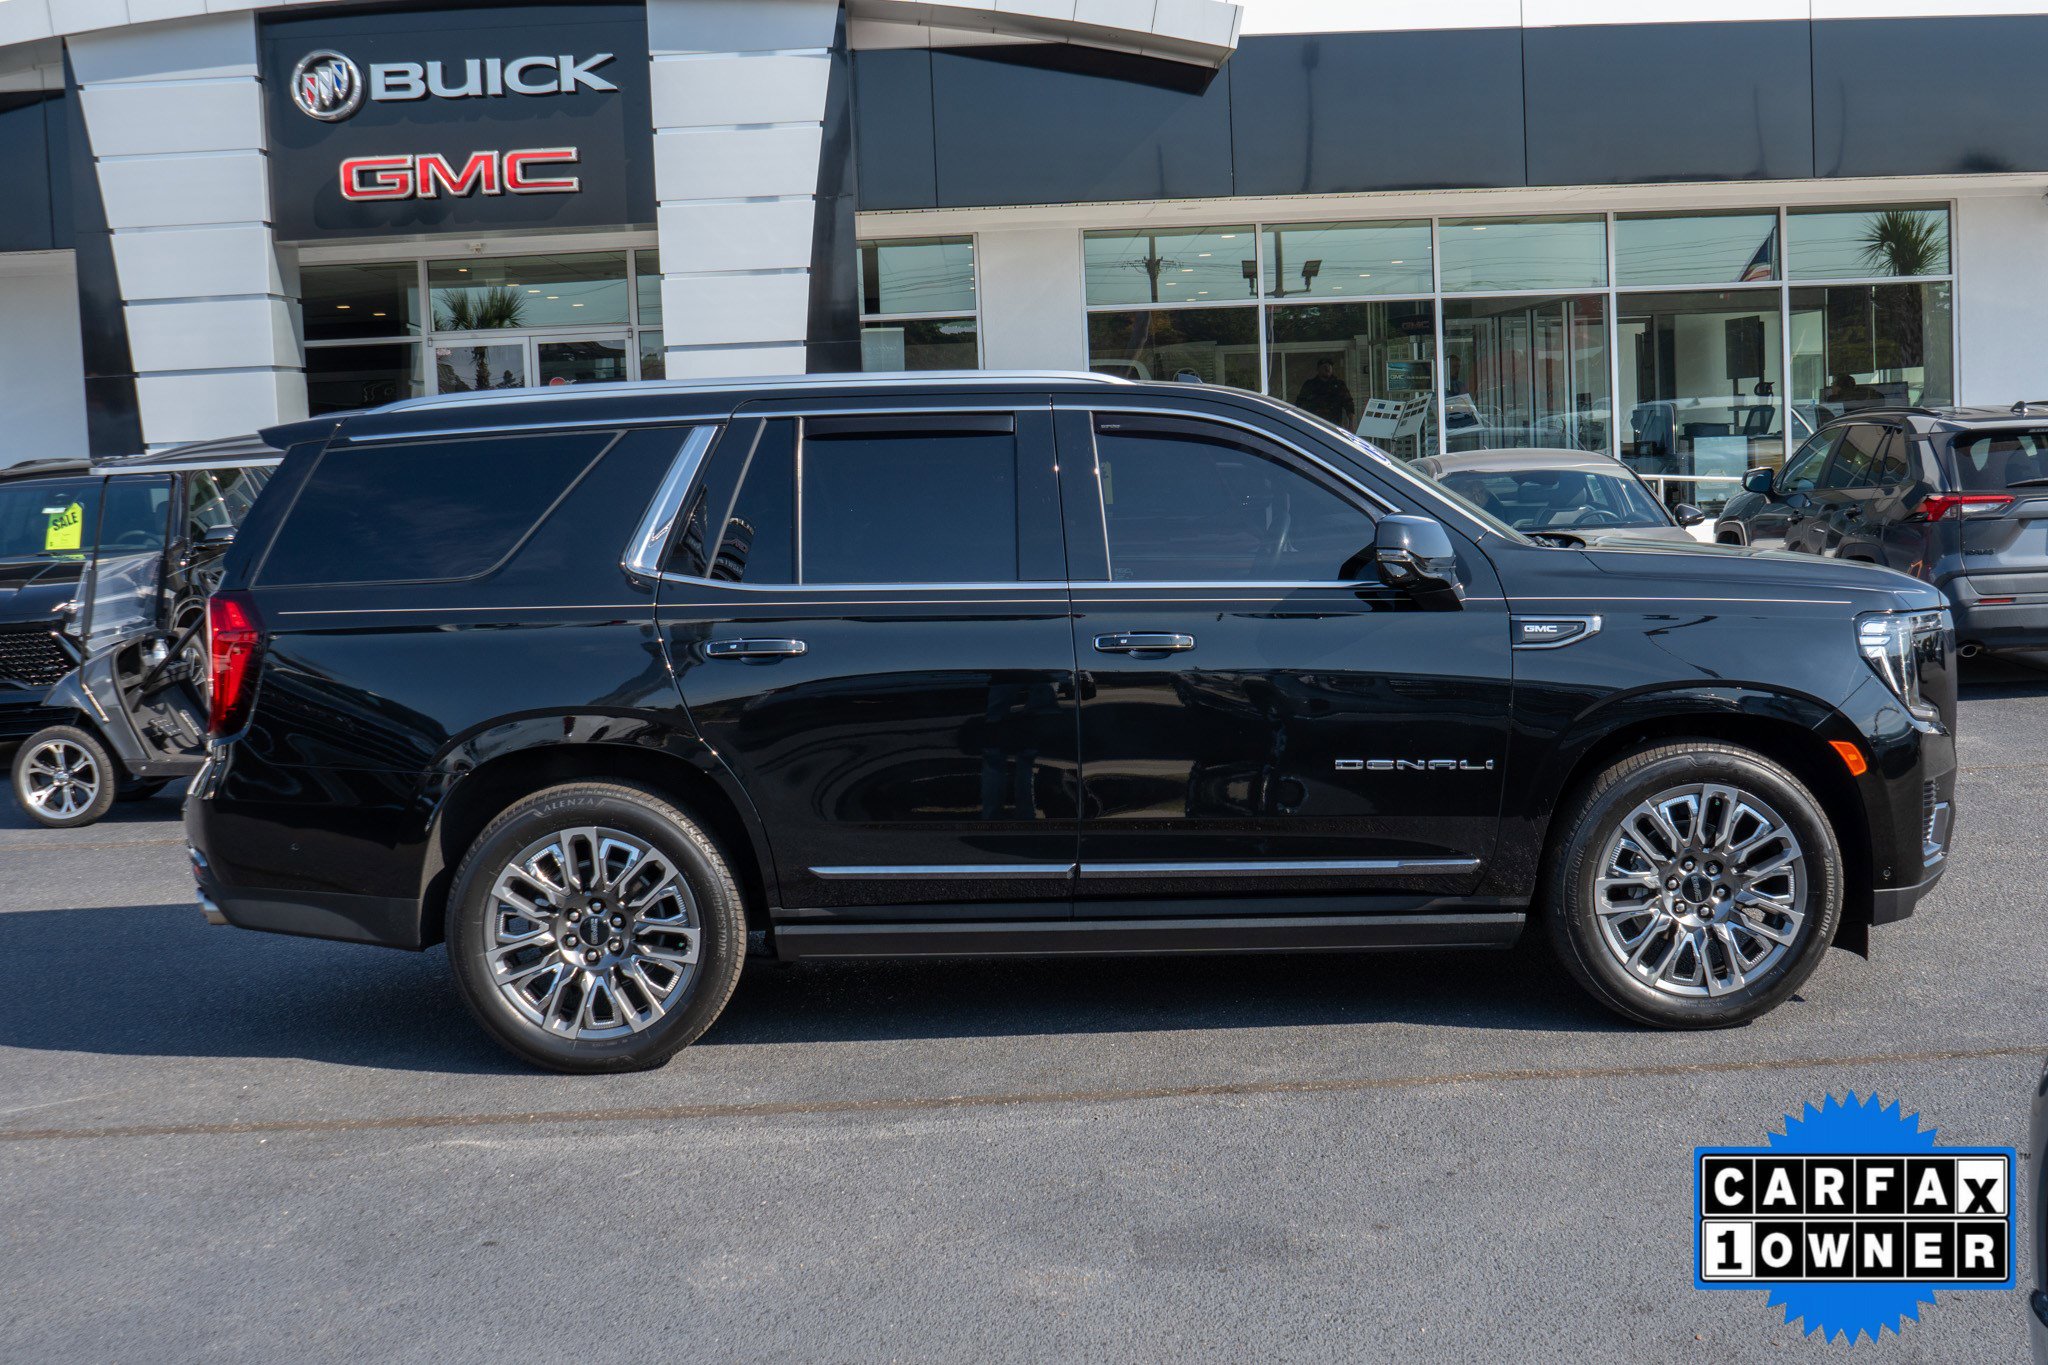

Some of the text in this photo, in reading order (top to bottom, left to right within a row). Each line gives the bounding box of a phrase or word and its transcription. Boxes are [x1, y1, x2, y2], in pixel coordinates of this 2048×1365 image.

[369, 53, 618, 101] BUICK
[339, 147, 580, 201] GMC
[53, 512, 79, 531] SALE
[1524, 625, 1558, 633] GMC
[1335, 759, 1494, 771] DENALI
[544, 798, 594, 812] ALENZA
[1818, 857, 1835, 939] BRIDGESTONE
